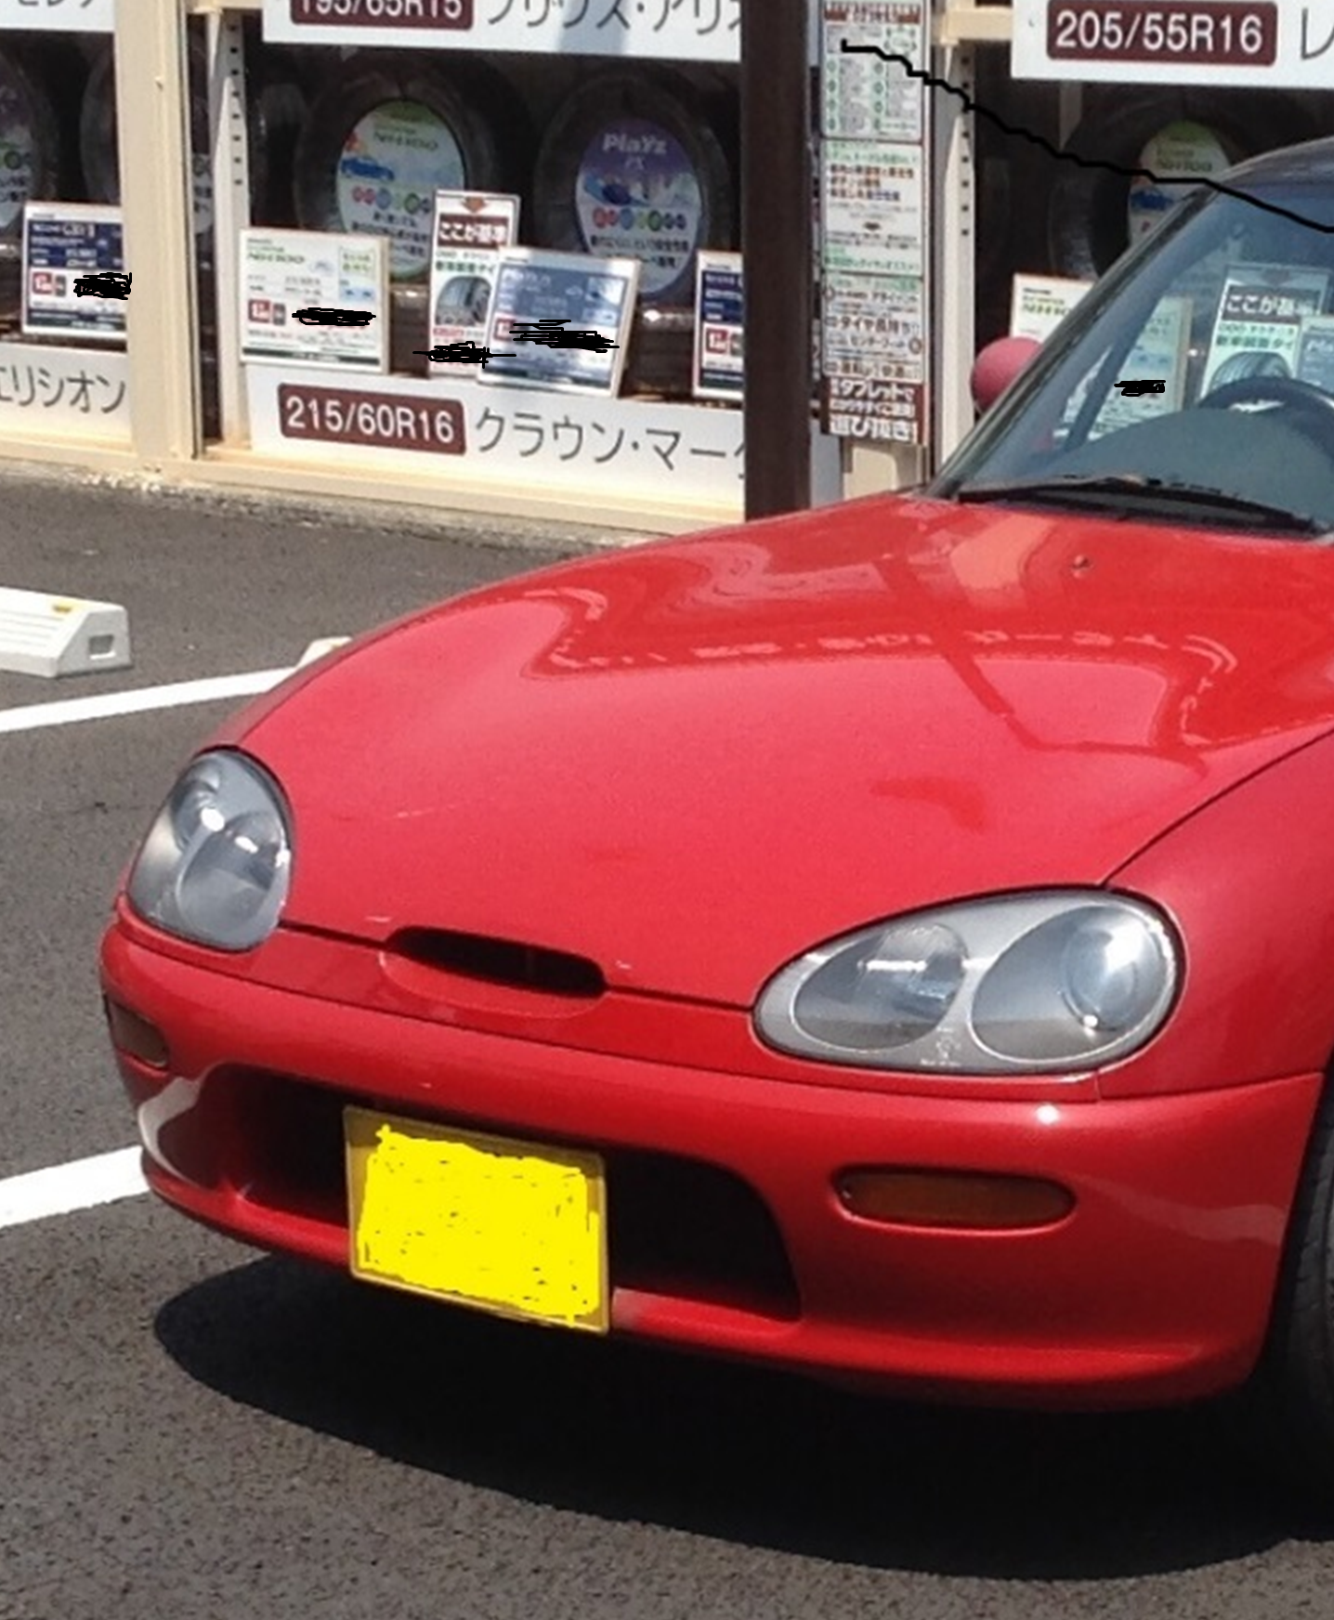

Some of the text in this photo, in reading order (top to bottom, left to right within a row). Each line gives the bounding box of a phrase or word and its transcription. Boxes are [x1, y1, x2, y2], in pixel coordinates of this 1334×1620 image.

[1055, 8, 1264, 54] 205/55R16
[286, 396, 744, 480] 215/60R16 クラウン・マー
